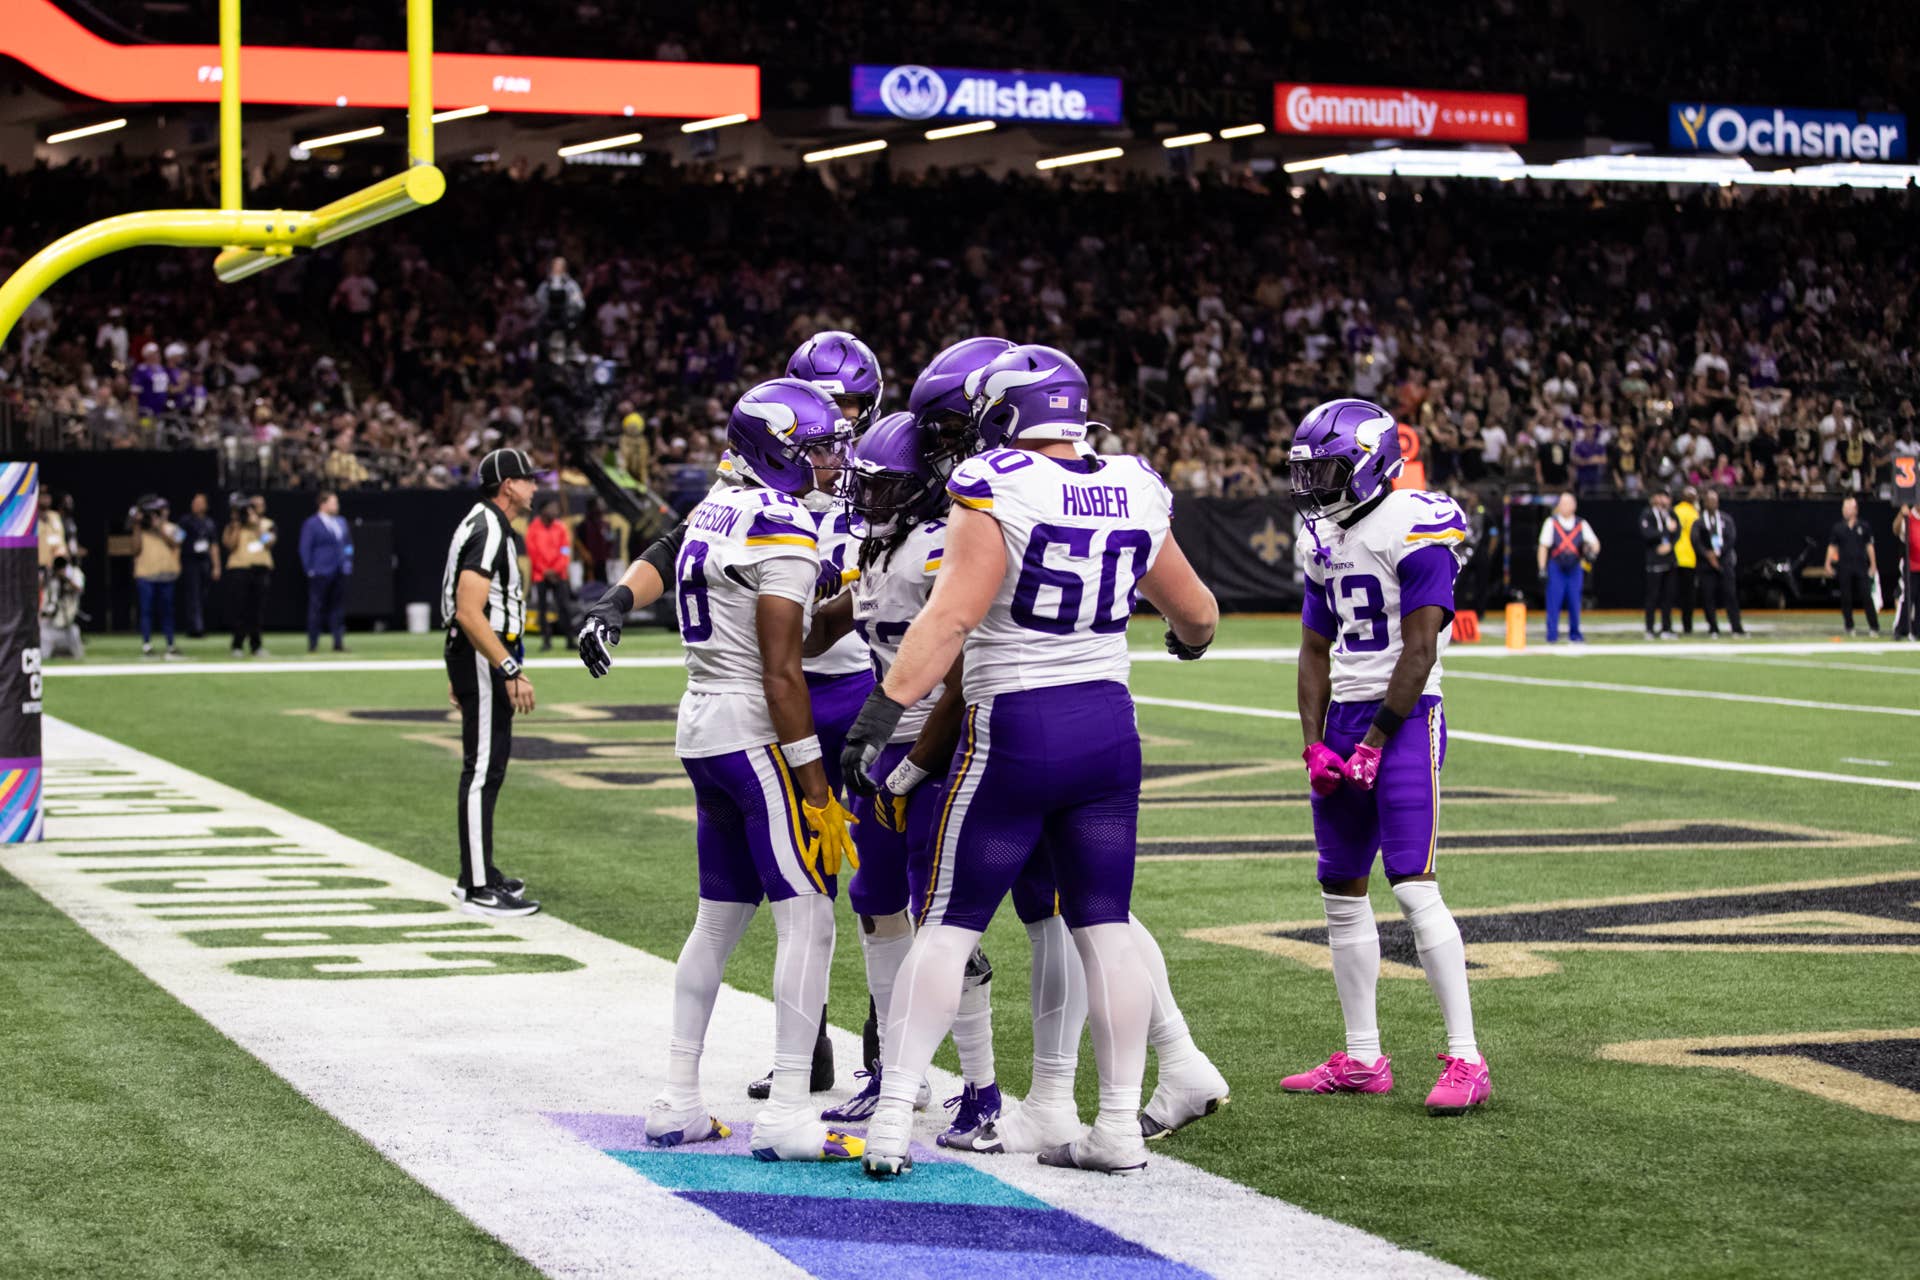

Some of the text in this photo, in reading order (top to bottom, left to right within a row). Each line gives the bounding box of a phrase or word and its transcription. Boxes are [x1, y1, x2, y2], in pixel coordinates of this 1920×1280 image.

[197, 65, 223, 83] FA
[492, 75, 532, 93] FAN
[946, 78, 1087, 120] Allstate
[1286, 86, 1438, 137] Community
[1706, 107, 1898, 160] Ochsner
[1895, 456, 1916, 489] 3
[1062, 483, 1130, 519] HUBER
[1010, 523, 1152, 636] 60
[1324, 573, 1390, 655] 13
[1455, 616, 1475, 641] 10
[44, 826, 587, 980] CRUCIAL
